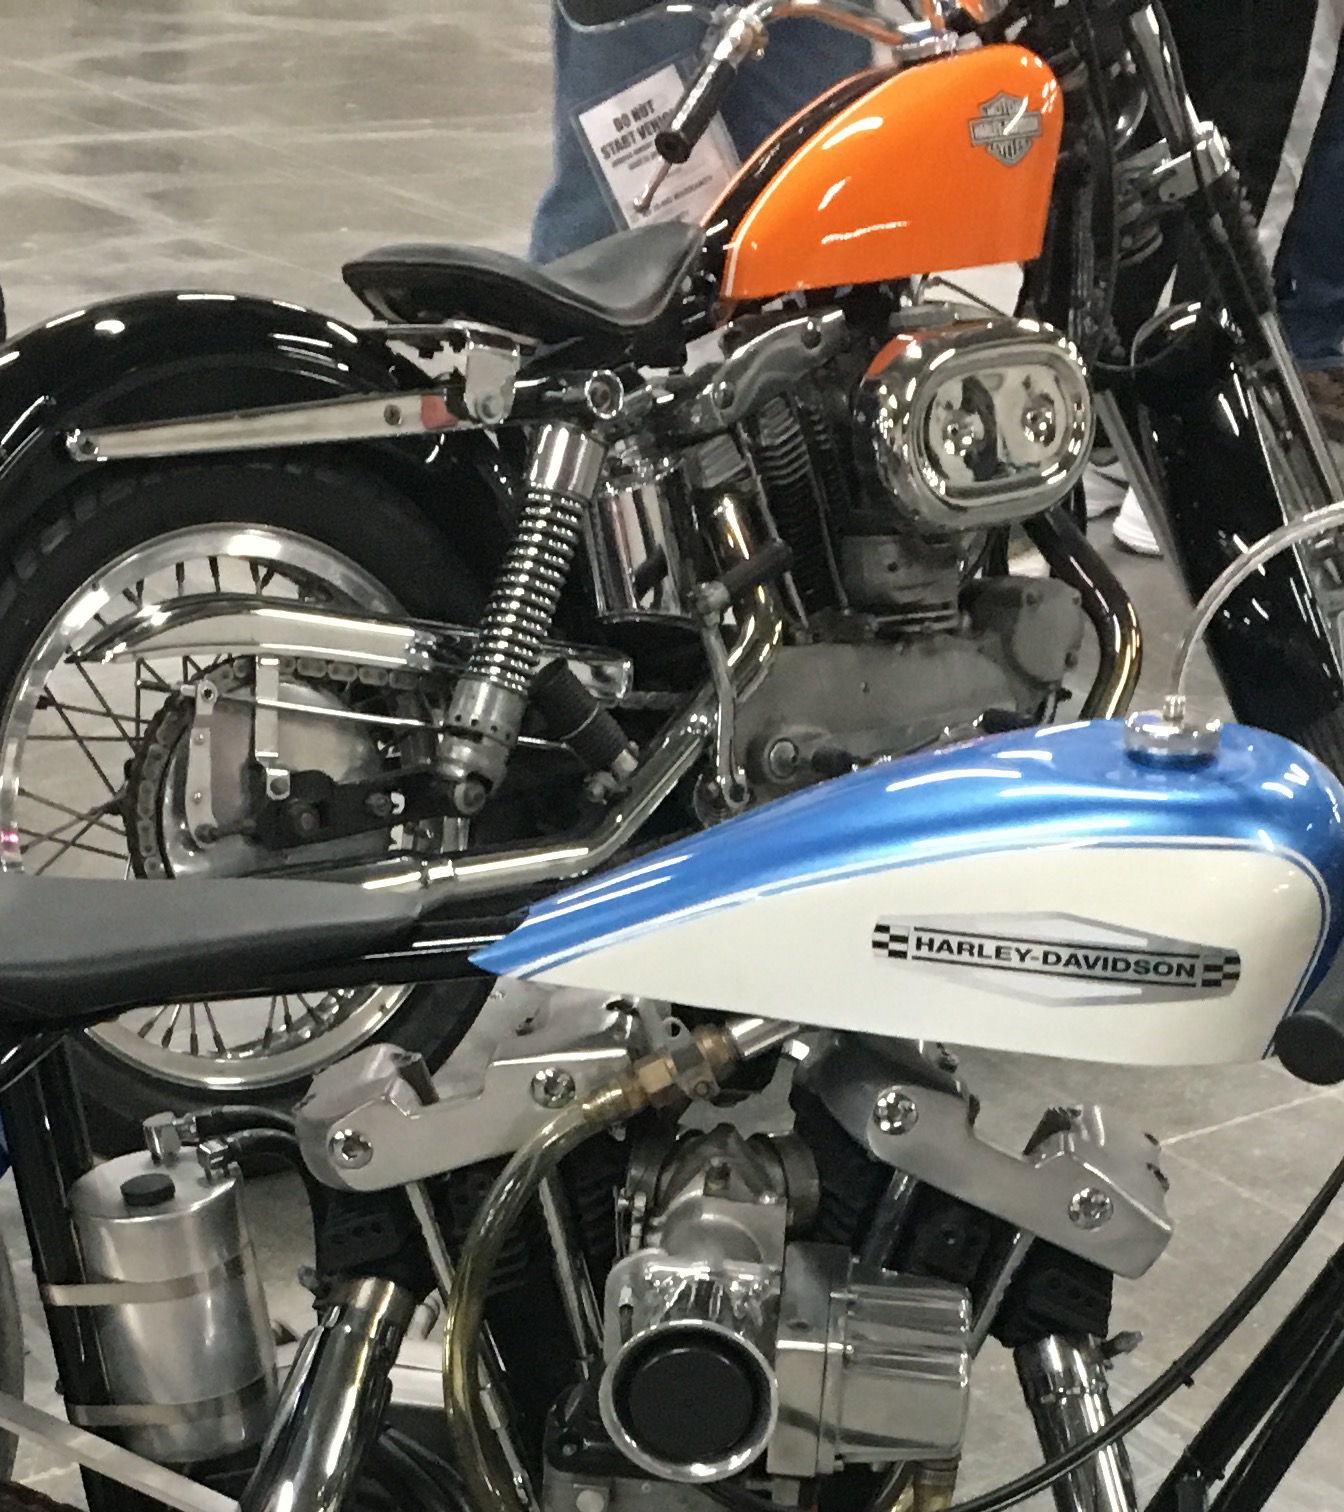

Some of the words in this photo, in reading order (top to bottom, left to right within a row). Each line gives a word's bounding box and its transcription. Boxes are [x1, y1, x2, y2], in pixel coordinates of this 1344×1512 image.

[613, 113, 631, 133] DO
[631, 100, 655, 122] NOT
[601, 131, 637, 160] START
[915, 936, 1196, 978] HARLEY-DAVIDSON
